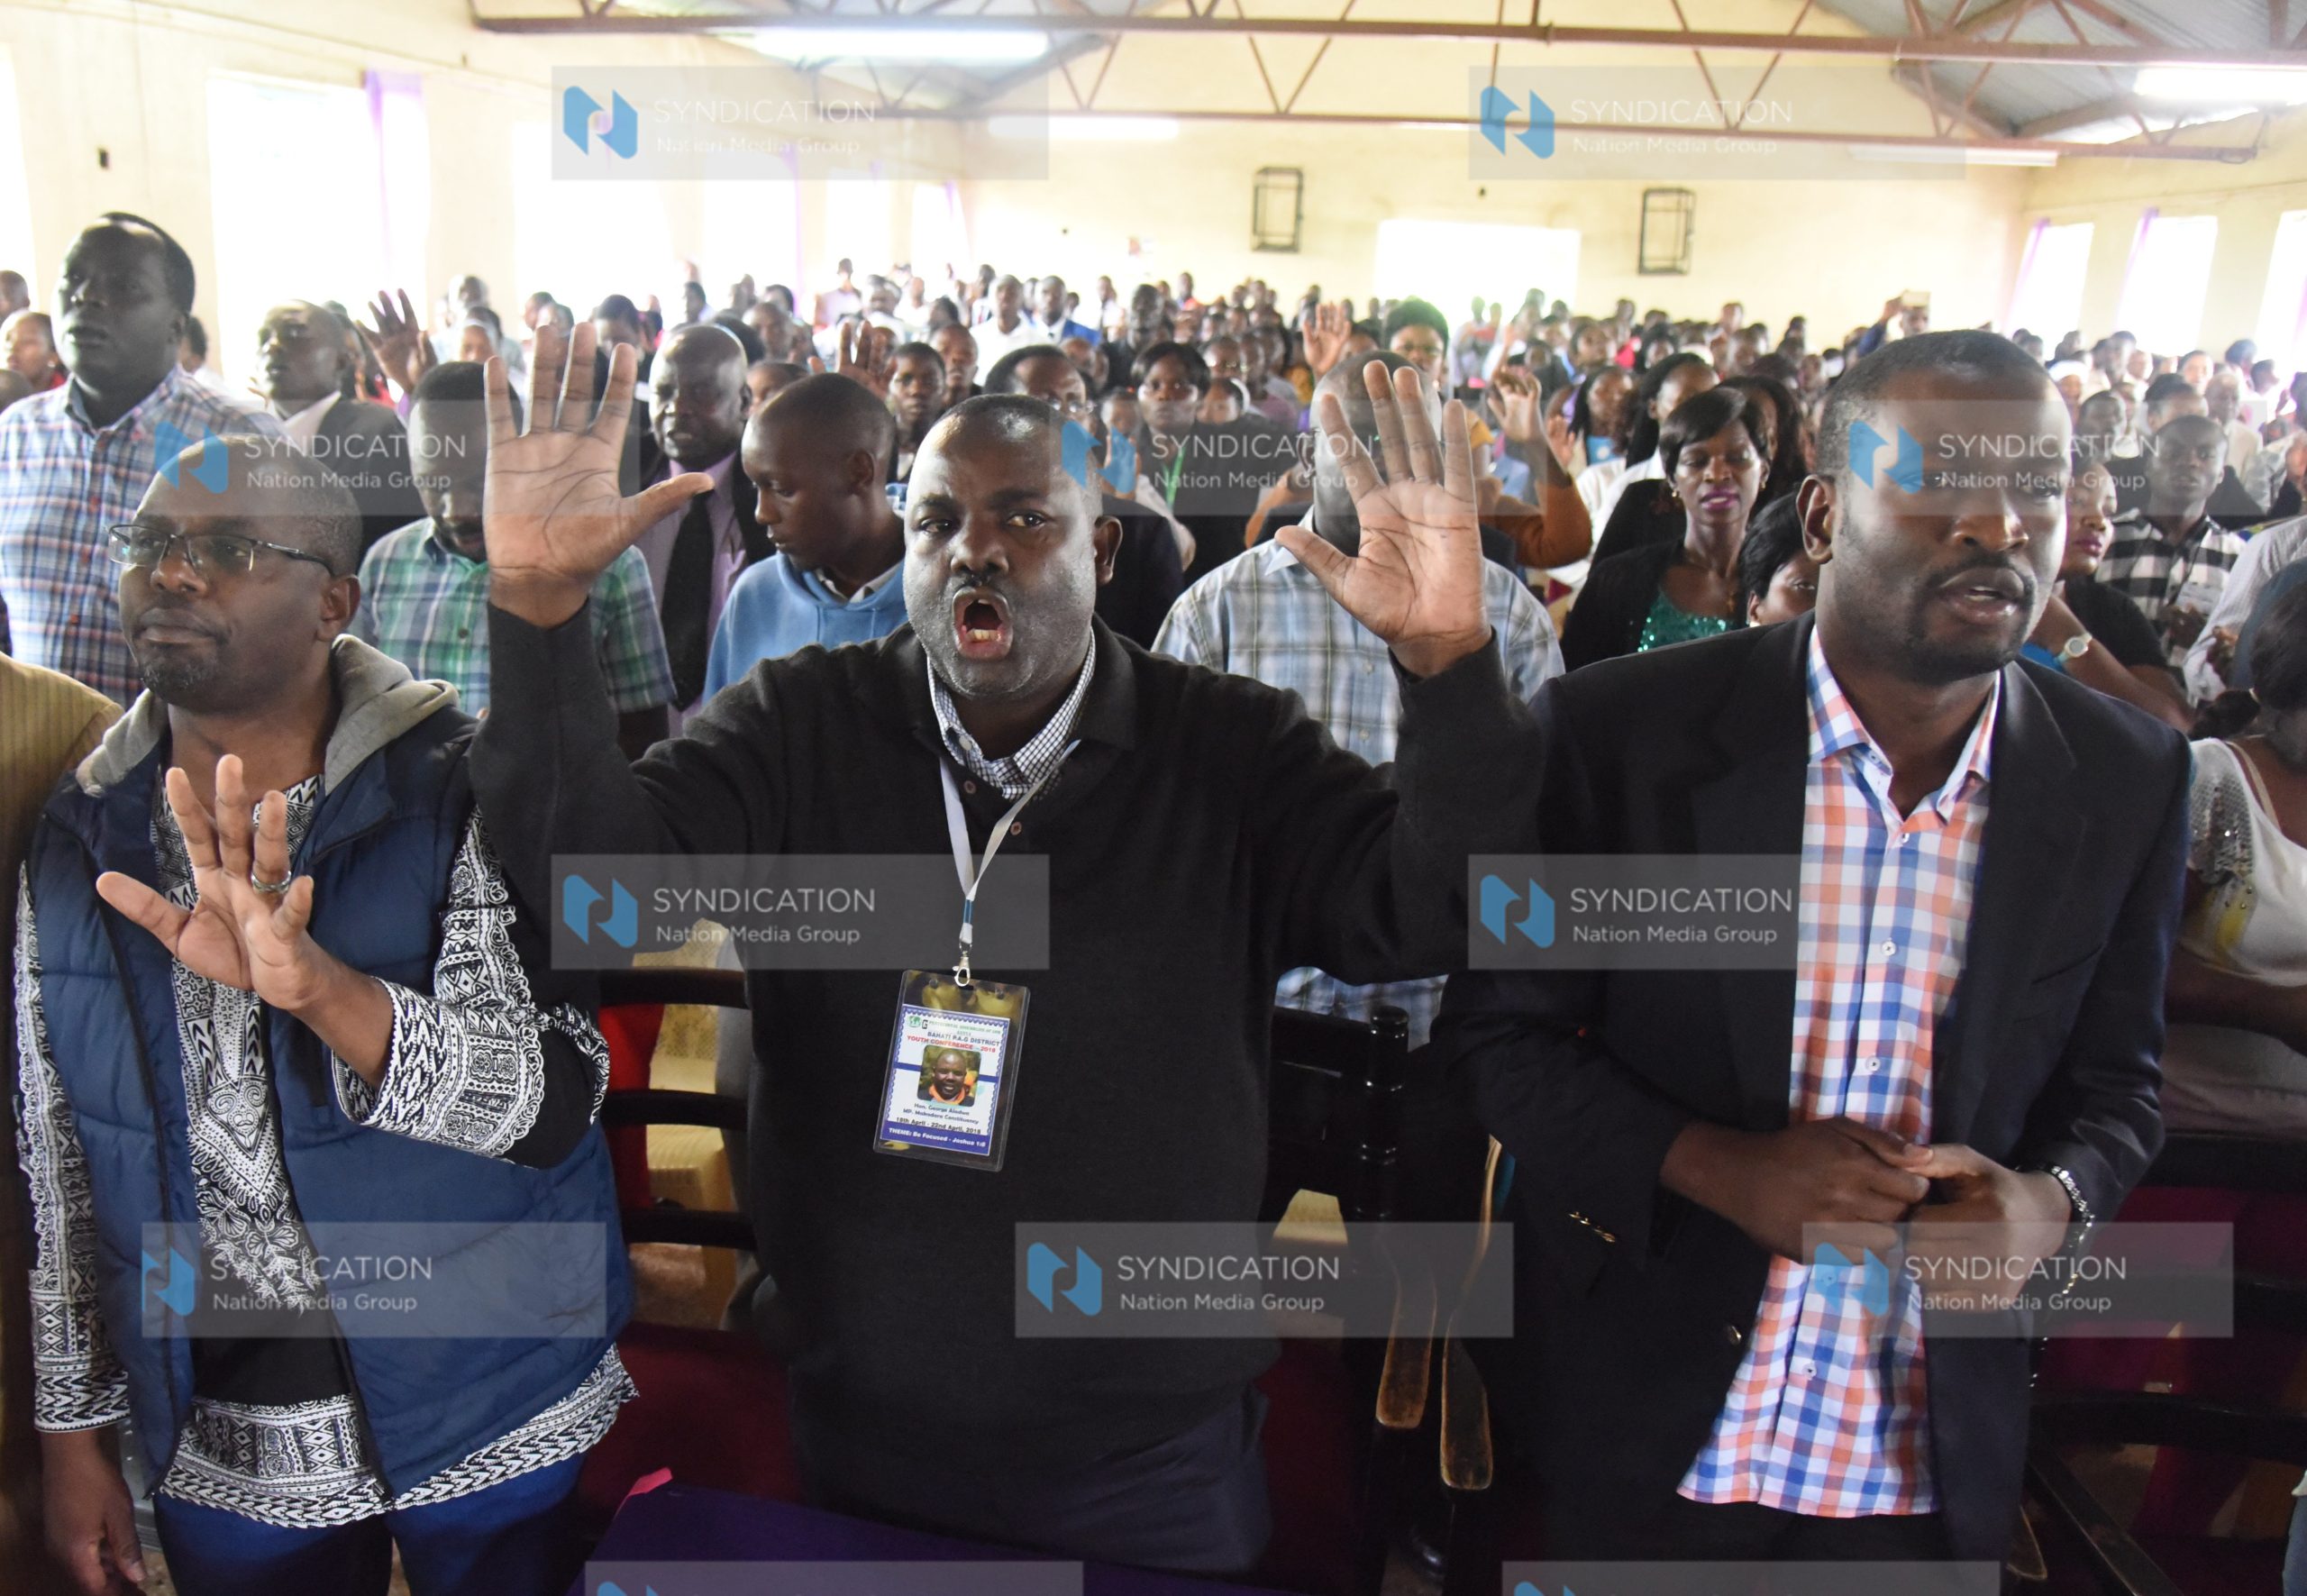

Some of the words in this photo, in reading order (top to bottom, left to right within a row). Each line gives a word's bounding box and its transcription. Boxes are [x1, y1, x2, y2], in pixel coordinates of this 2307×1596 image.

[907, 1035, 929, 1043] YOUTH
[930, 1038, 973, 1050] CONFERENCE
[971, 1037, 1000, 1046] DISTRICT
[944, 1114, 980, 1125] Constituency
[889, 1127, 911, 1136] THEME:
[922, 1133, 948, 1142] Focused
[952, 1137, 975, 1146] Joshua
